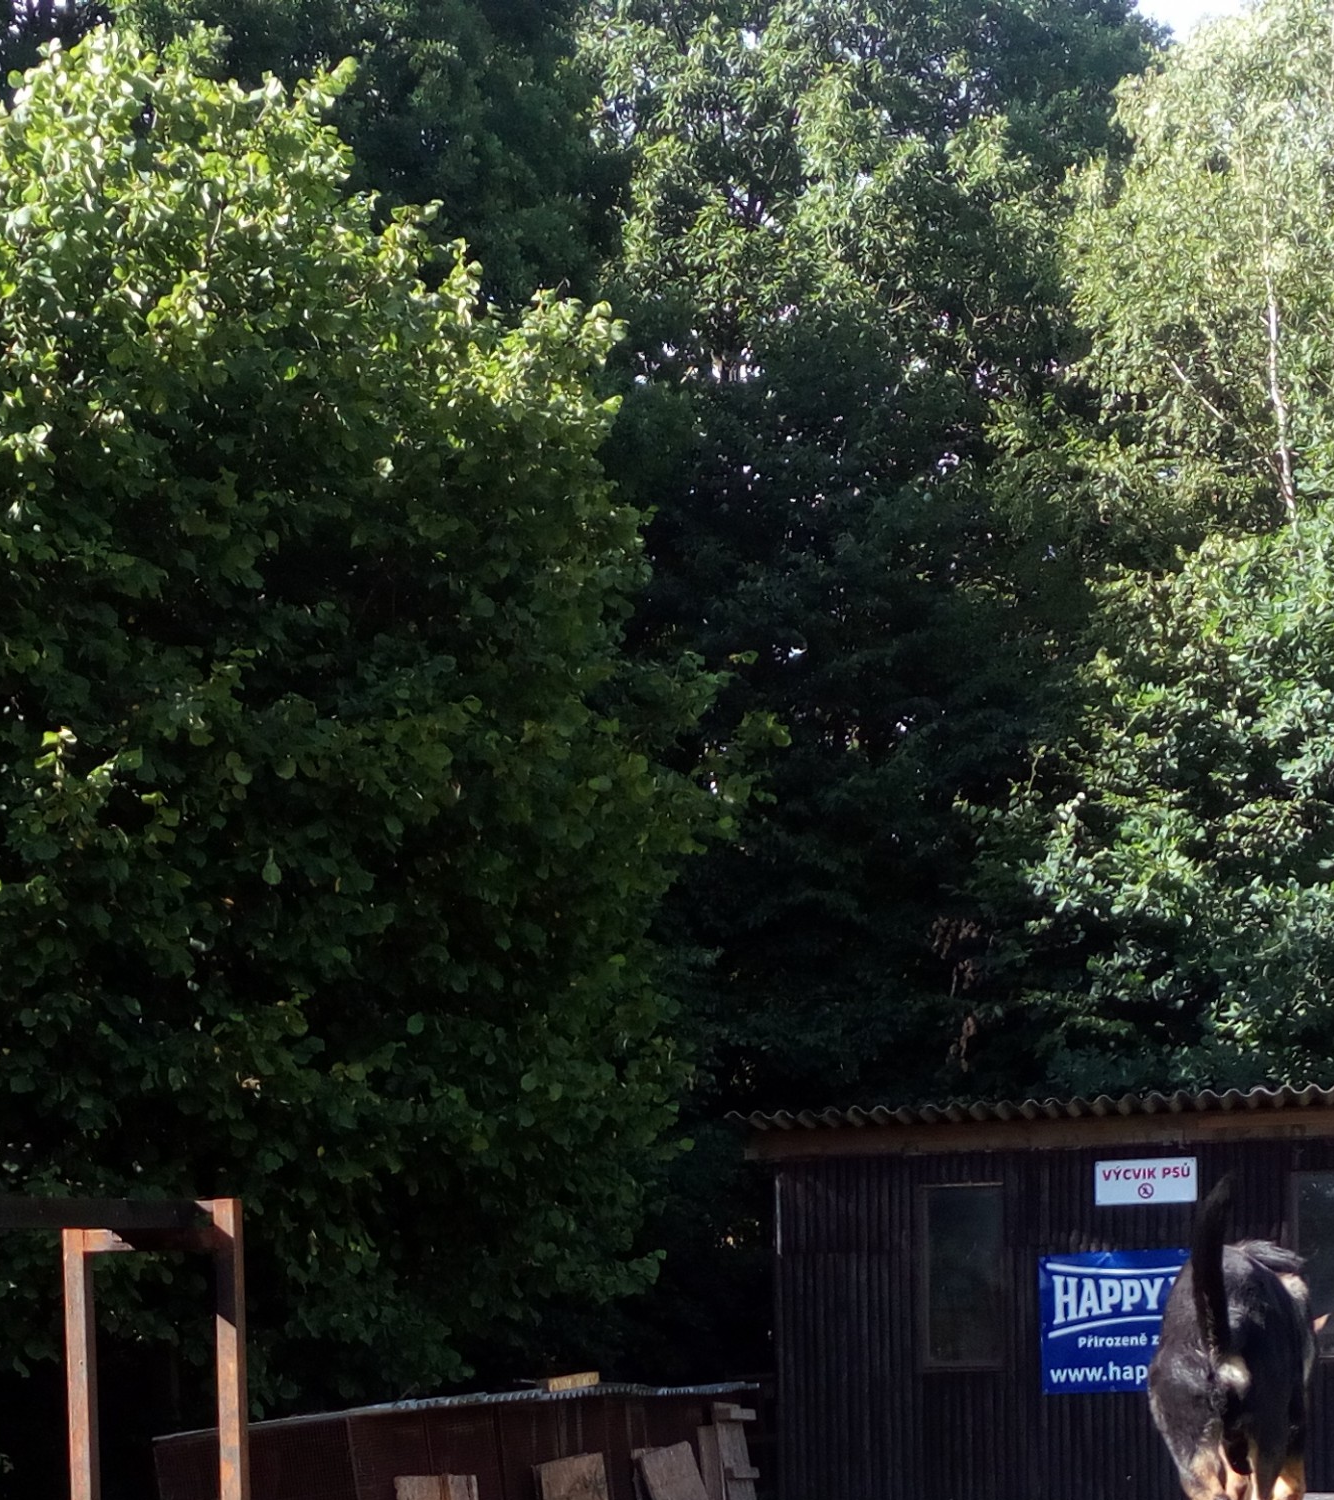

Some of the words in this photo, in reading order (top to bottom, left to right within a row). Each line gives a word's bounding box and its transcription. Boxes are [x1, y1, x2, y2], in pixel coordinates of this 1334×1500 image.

[1102, 1165, 1157, 1181] VÝCVIK
[1162, 1162, 1191, 1179] PSŮ
[1052, 1275, 1165, 1325] HAPPY
[1078, 1332, 1148, 1349] Přirozeně
